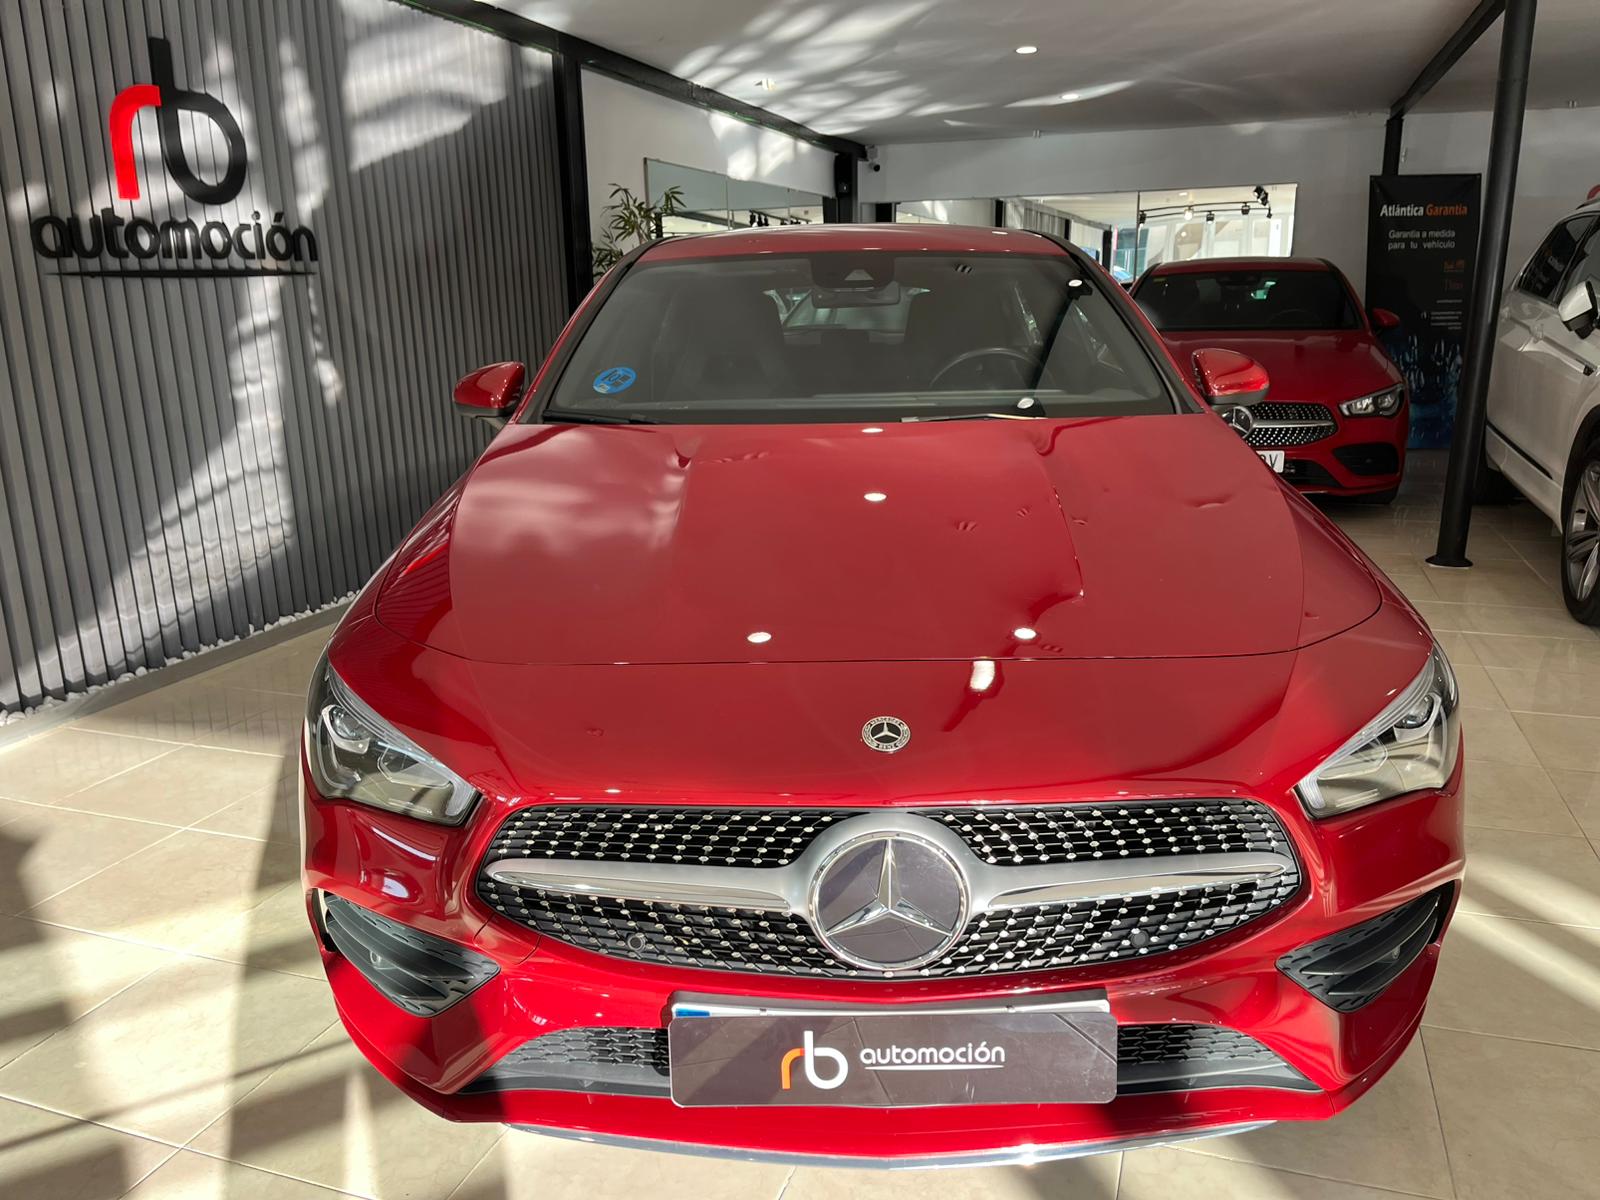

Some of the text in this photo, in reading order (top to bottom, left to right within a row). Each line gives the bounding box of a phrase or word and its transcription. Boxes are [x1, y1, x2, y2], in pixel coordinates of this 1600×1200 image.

[1380, 204, 1424, 217] Atlántica
[32, 208, 318, 261] automoción
[1422, 231, 1427, 239] a
[1428, 229, 1455, 239] medida
[1388, 241, 1405, 251] para
[1410, 240, 1418, 249] tu
[781, 1030, 1006, 1089] rb automoción
